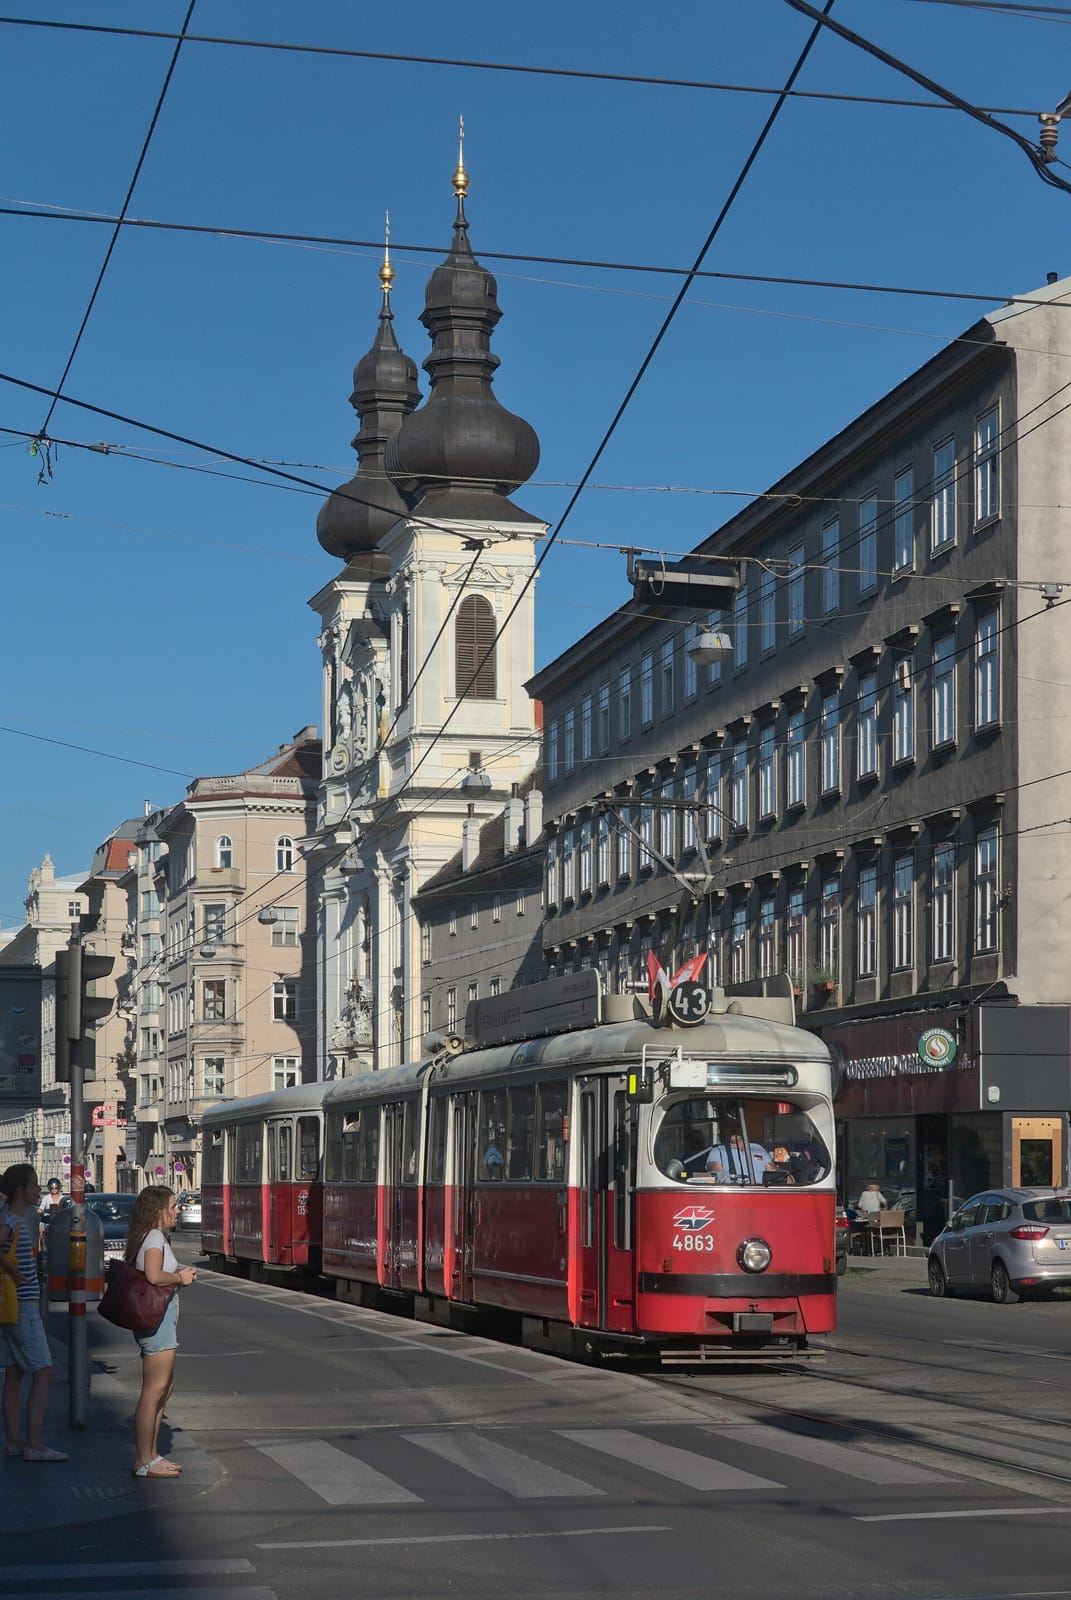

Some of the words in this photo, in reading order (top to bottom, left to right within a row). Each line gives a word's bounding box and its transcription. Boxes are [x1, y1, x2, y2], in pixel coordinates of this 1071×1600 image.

[675, 988, 707, 1016] 43
[922, 1028, 954, 1042] COFFEESHOP
[923, 1055, 950, 1066] COMPANY
[672, 1234, 714, 1251] 4863
